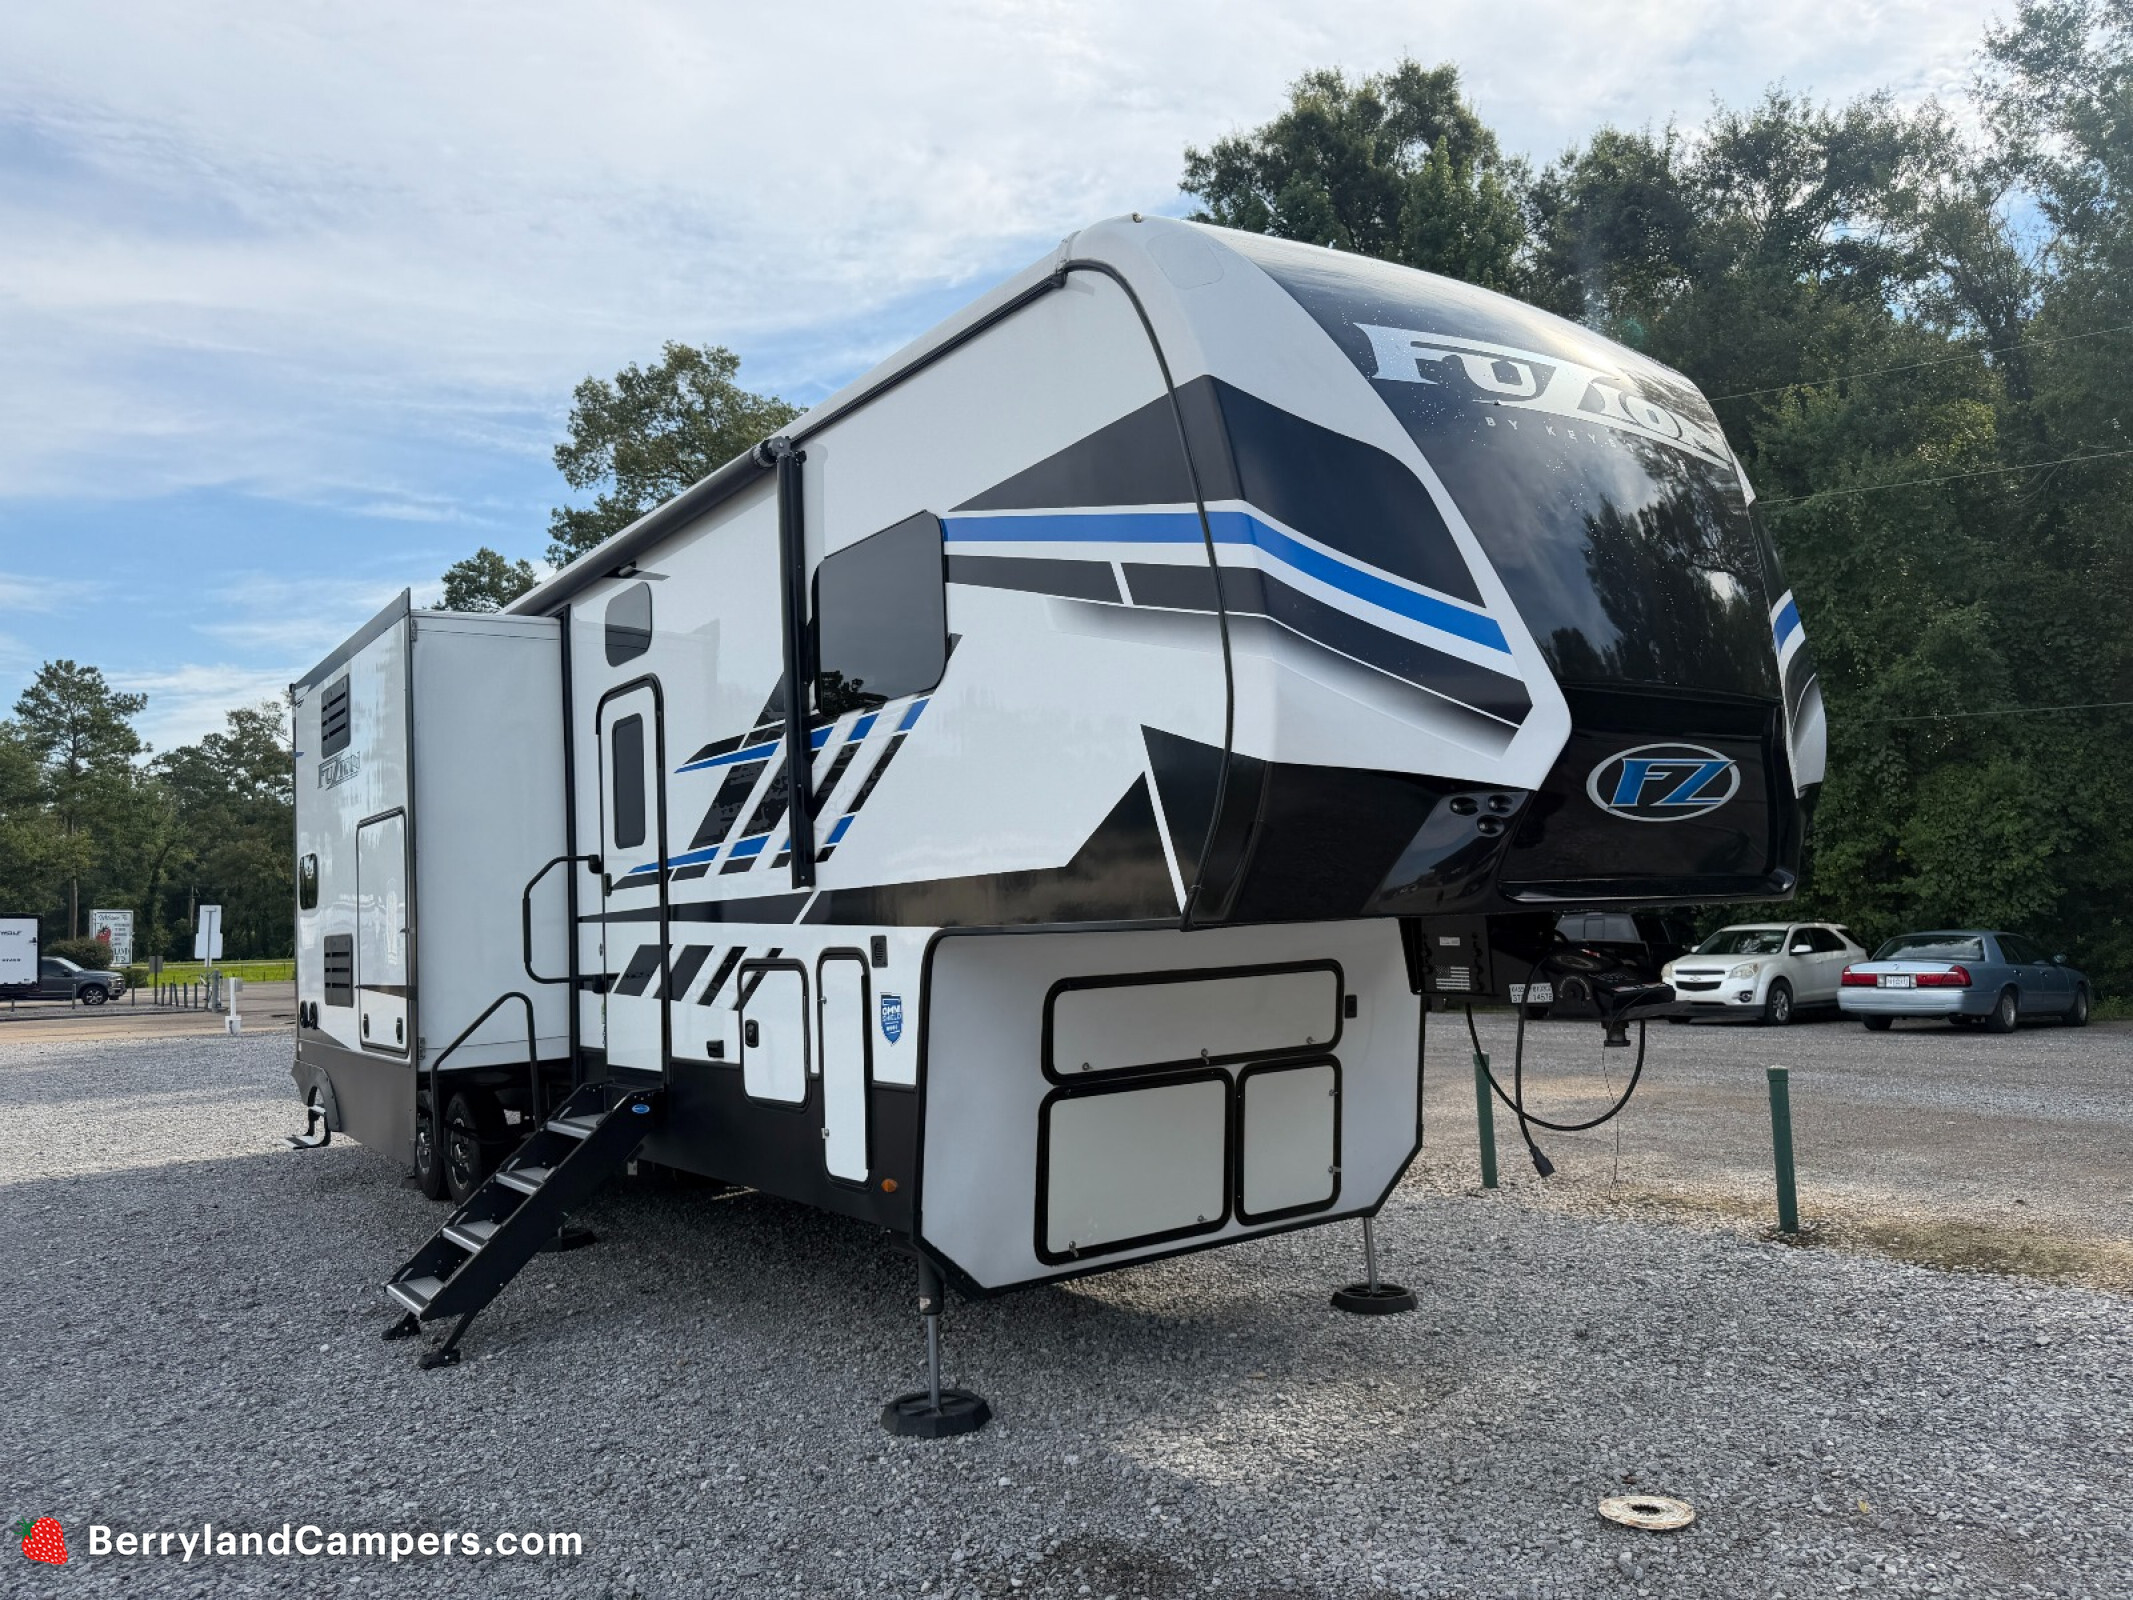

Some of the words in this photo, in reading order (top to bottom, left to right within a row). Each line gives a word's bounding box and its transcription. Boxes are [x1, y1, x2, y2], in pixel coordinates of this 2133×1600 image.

[1485, 416, 1518, 430] BY
[1546, 425, 1687, 471] KEYSTONE
[1608, 758, 1737, 807] FZ
